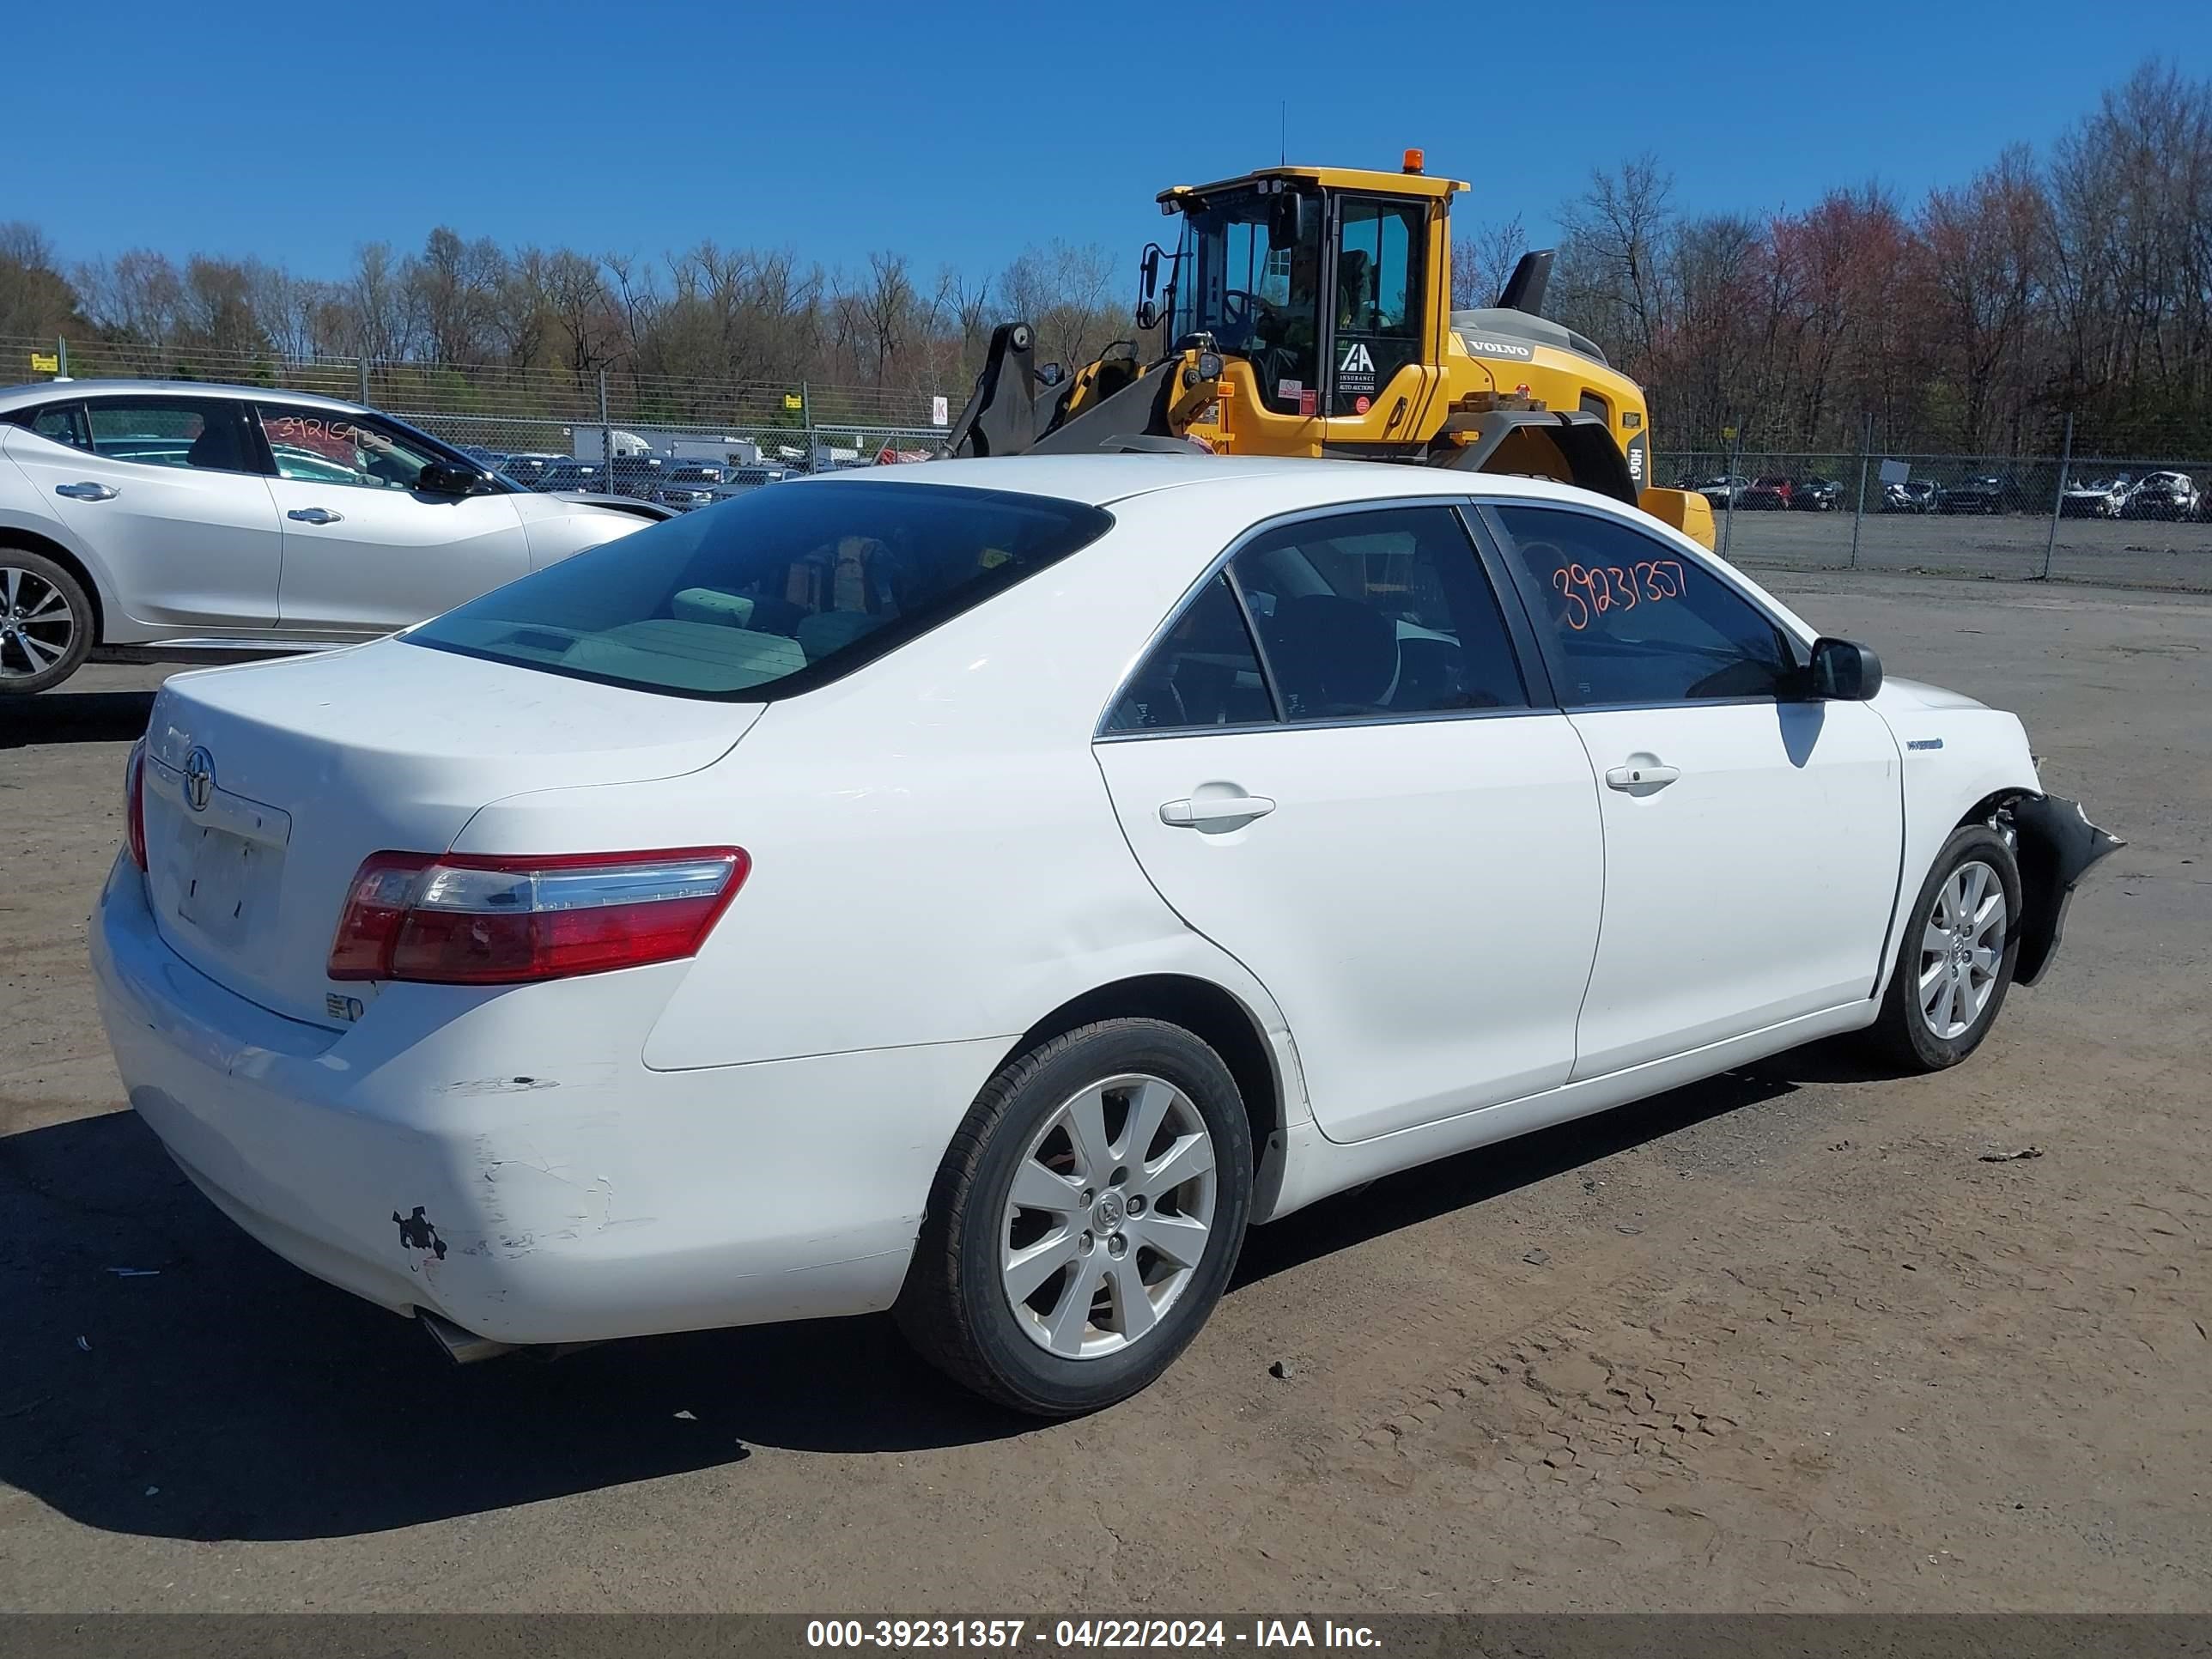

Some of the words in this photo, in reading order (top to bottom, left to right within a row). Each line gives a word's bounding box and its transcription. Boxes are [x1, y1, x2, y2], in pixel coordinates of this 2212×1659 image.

[1468, 340, 1528, 356] VOLVO
[1630, 448, 1643, 480] L90H
[1553, 560, 1687, 629] 39231357
